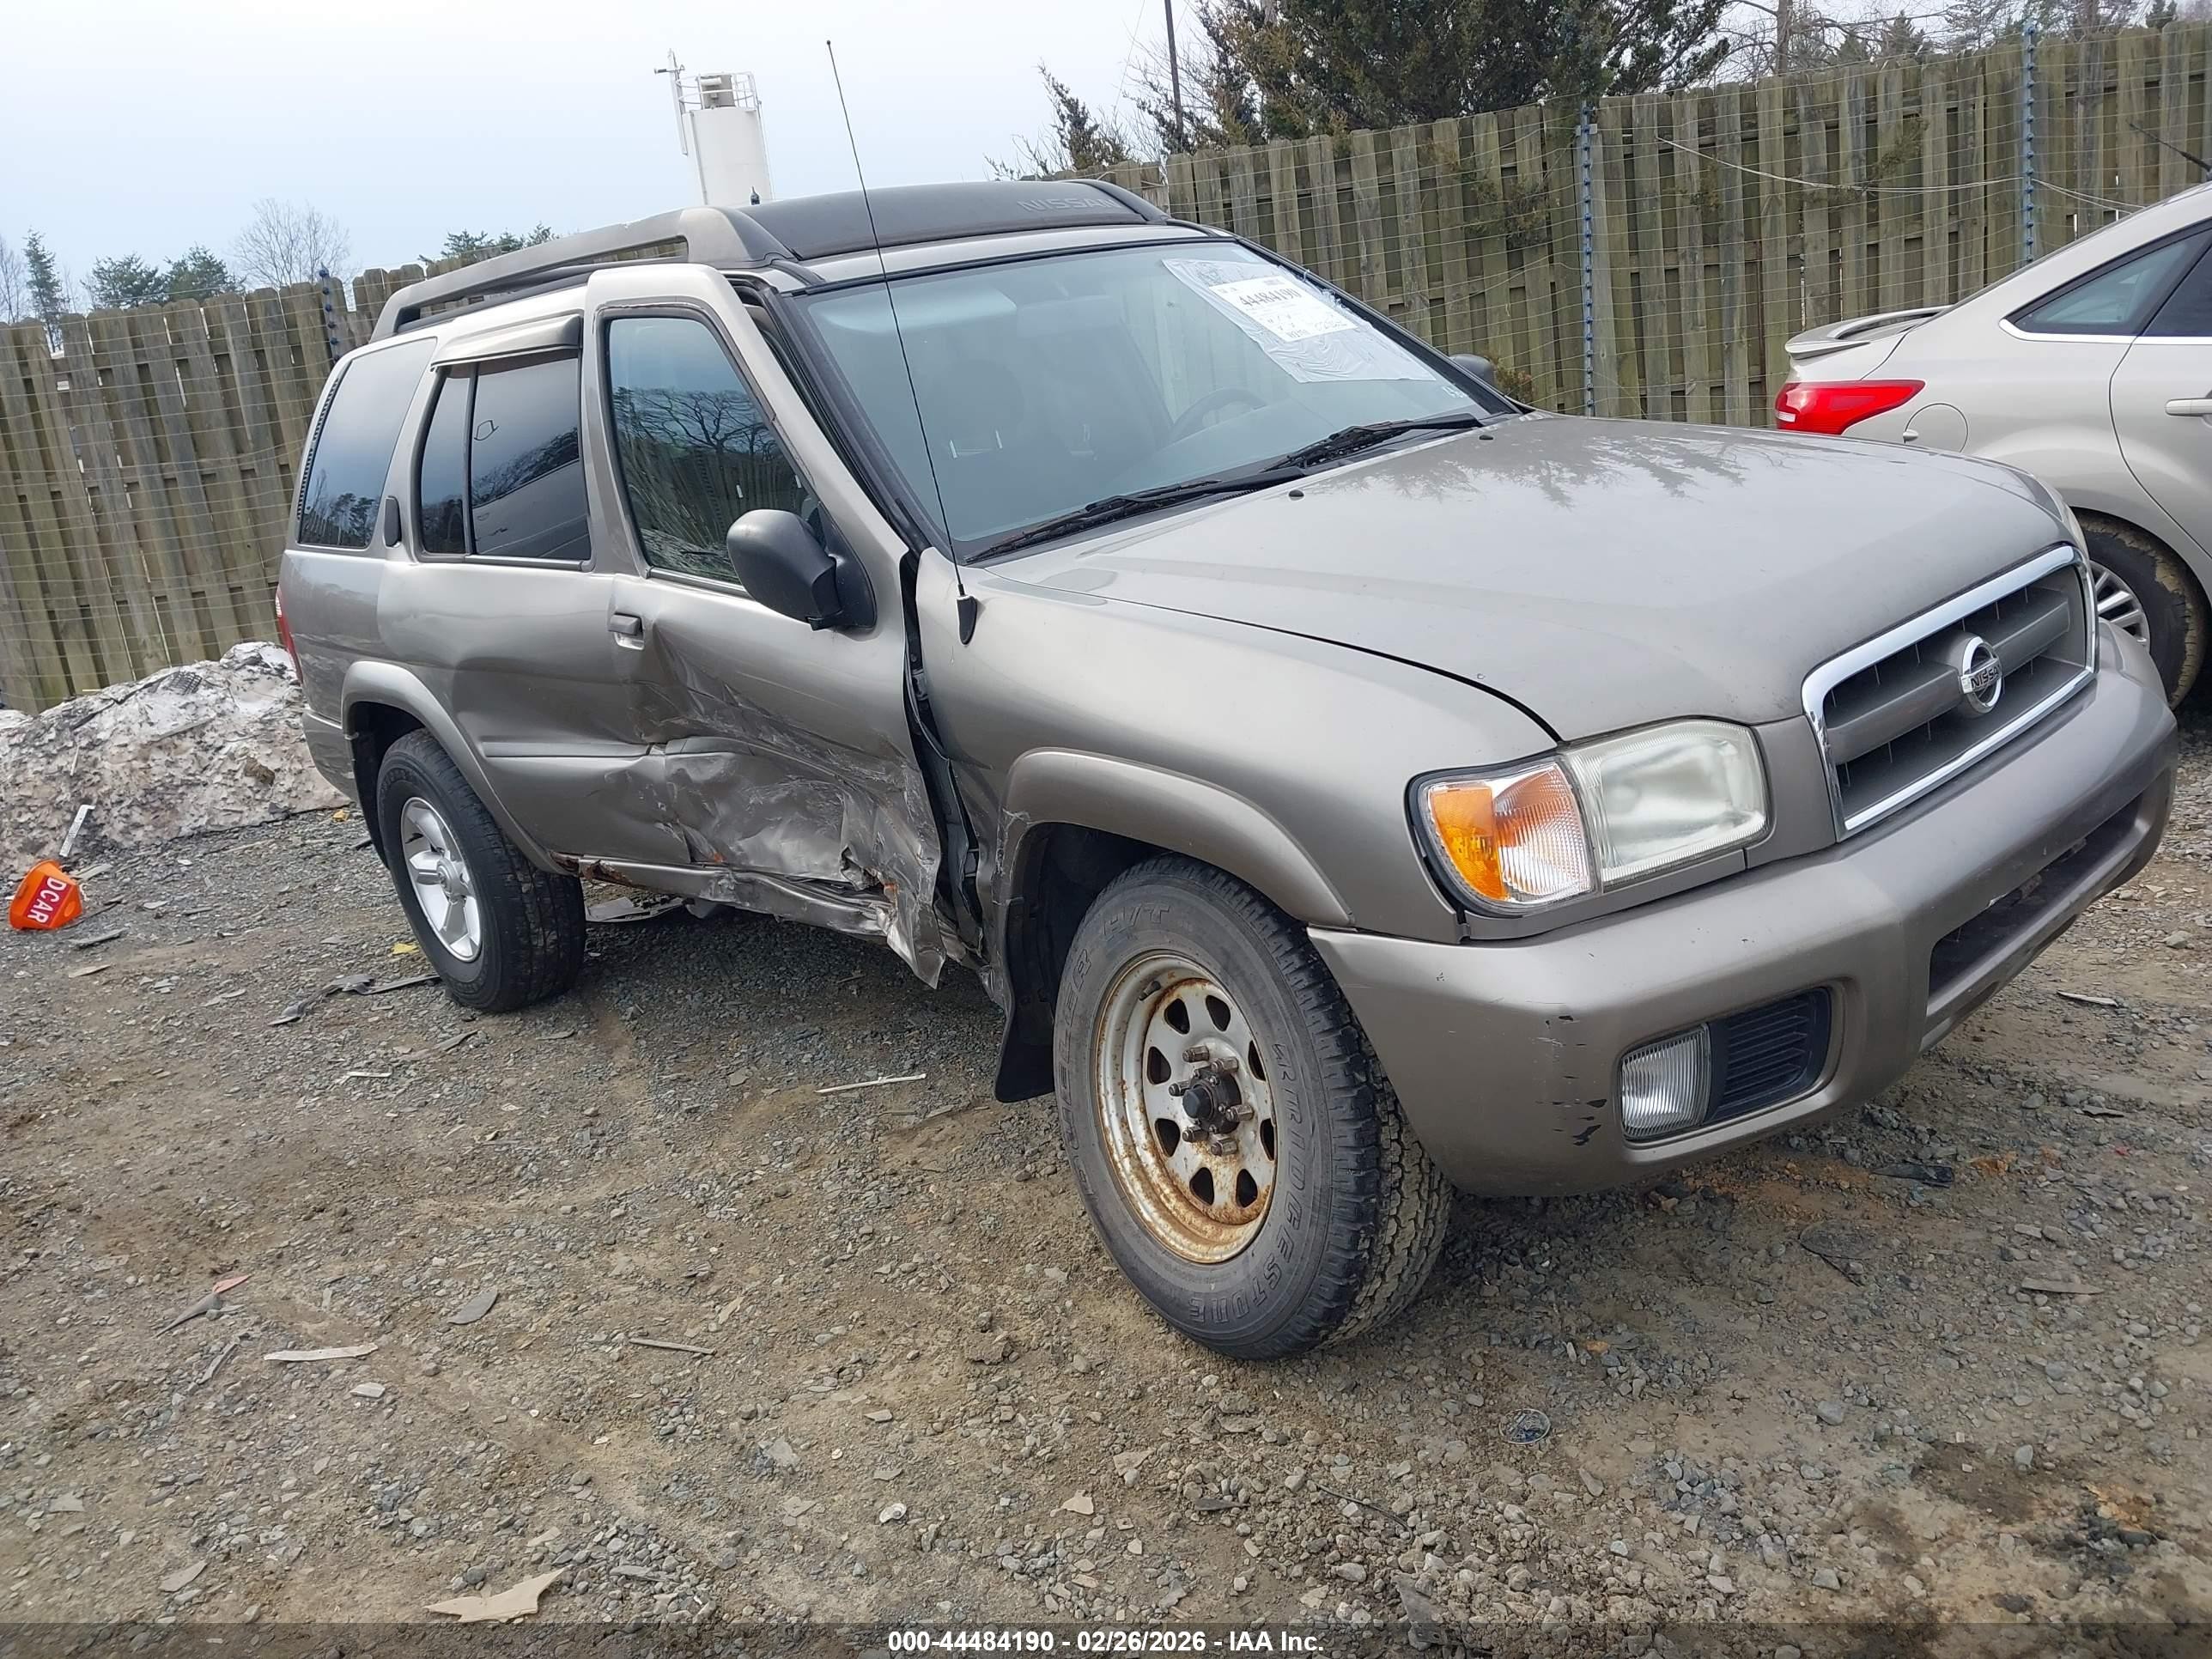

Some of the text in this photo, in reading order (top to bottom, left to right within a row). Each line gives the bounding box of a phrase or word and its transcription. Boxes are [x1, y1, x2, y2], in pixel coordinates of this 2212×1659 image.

[1017, 198, 1122, 213] NISSAN
[1238, 288, 1303, 307] 44484190
[1971, 664, 2000, 688] NISSA
[27, 877, 67, 923] DCAR
[1188, 1042, 1306, 1323] BRIDGESTONE
